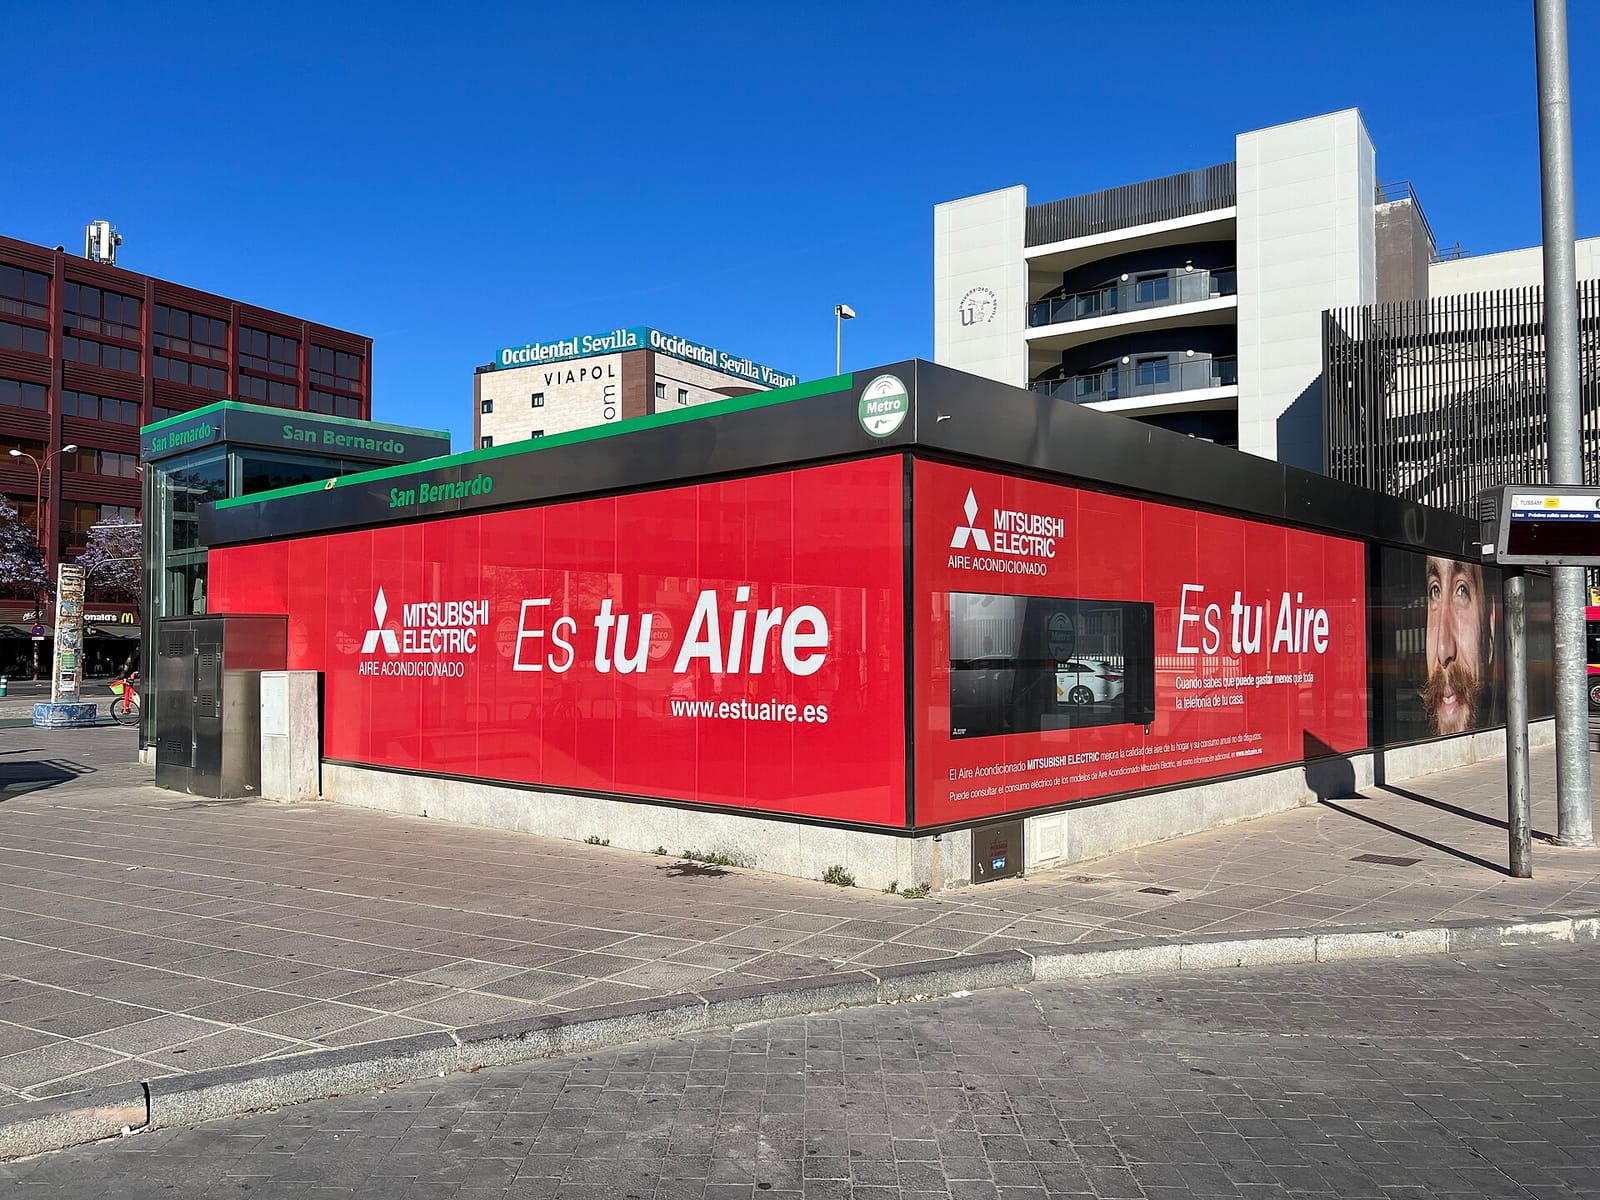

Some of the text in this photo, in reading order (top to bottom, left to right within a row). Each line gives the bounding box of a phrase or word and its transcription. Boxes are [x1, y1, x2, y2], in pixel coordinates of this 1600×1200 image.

[502, 337, 578, 365] Occidental
[583, 329, 637, 353] Sevilla
[650, 330, 796, 388] Occidental Sevilla Viapol
[544, 364, 615, 386] VIAPOL
[603, 384, 616, 420] om
[867, 400, 901, 414] Metro
[151, 422, 211, 452] San Bernardo
[282, 425, 405, 454] San Bernardo
[390, 473, 493, 508] San Bernardo
[993, 509, 1064, 538] MITSUBISHI
[994, 531, 1056, 558] ELECTRIC
[948, 555, 1047, 576] AIRE ACONDICIONADO
[84, 613, 117, 621] onald's
[403, 600, 489, 627] MITSUBISHI
[1177, 584, 1329, 655] Es tu Aire
[403, 627, 476, 654] ELECTRIC
[512, 585, 829, 676] Es tu Aire
[359, 661, 464, 678] AIRE ACONDICIONADO
[1176, 672, 1314, 690] Cuando sabes que puede gastar menos que toda
[670, 698, 828, 723] www.estuaire.es
[1176, 695, 1245, 710] la telefonía de tu casa.
[950, 768, 956, 780] El
[958, 767, 973, 779] Aire
[975, 761, 1025, 777] Acondicionado
[1027, 757, 1067, 770] MITSUBISHI
[1067, 752, 1100, 765] ELECTRIC
[1100, 751, 1119, 761] mejora
[1120, 749, 1125, 758] la
[1126, 746, 1144, 757] calidad
[1153, 744, 1163, 754] aire
[1163, 743, 1170, 752] de
[1176, 741, 1189, 752] hogar
[1193, 741, 1200, 749] su
[949, 791, 969, 801] Puede
[970, 787, 997, 799] consultar
[998, 785, 1003, 793] el
[1004, 783, 1029, 793] consumo
[1031, 778, 1053, 789] eléctrico
[1053, 777, 1061, 785] de
[1061, 776, 1069, 784] los
[1069, 773, 1090, 783] modelos
[1091, 772, 1098, 780] de
[1098, 770, 1108, 778] Aire
